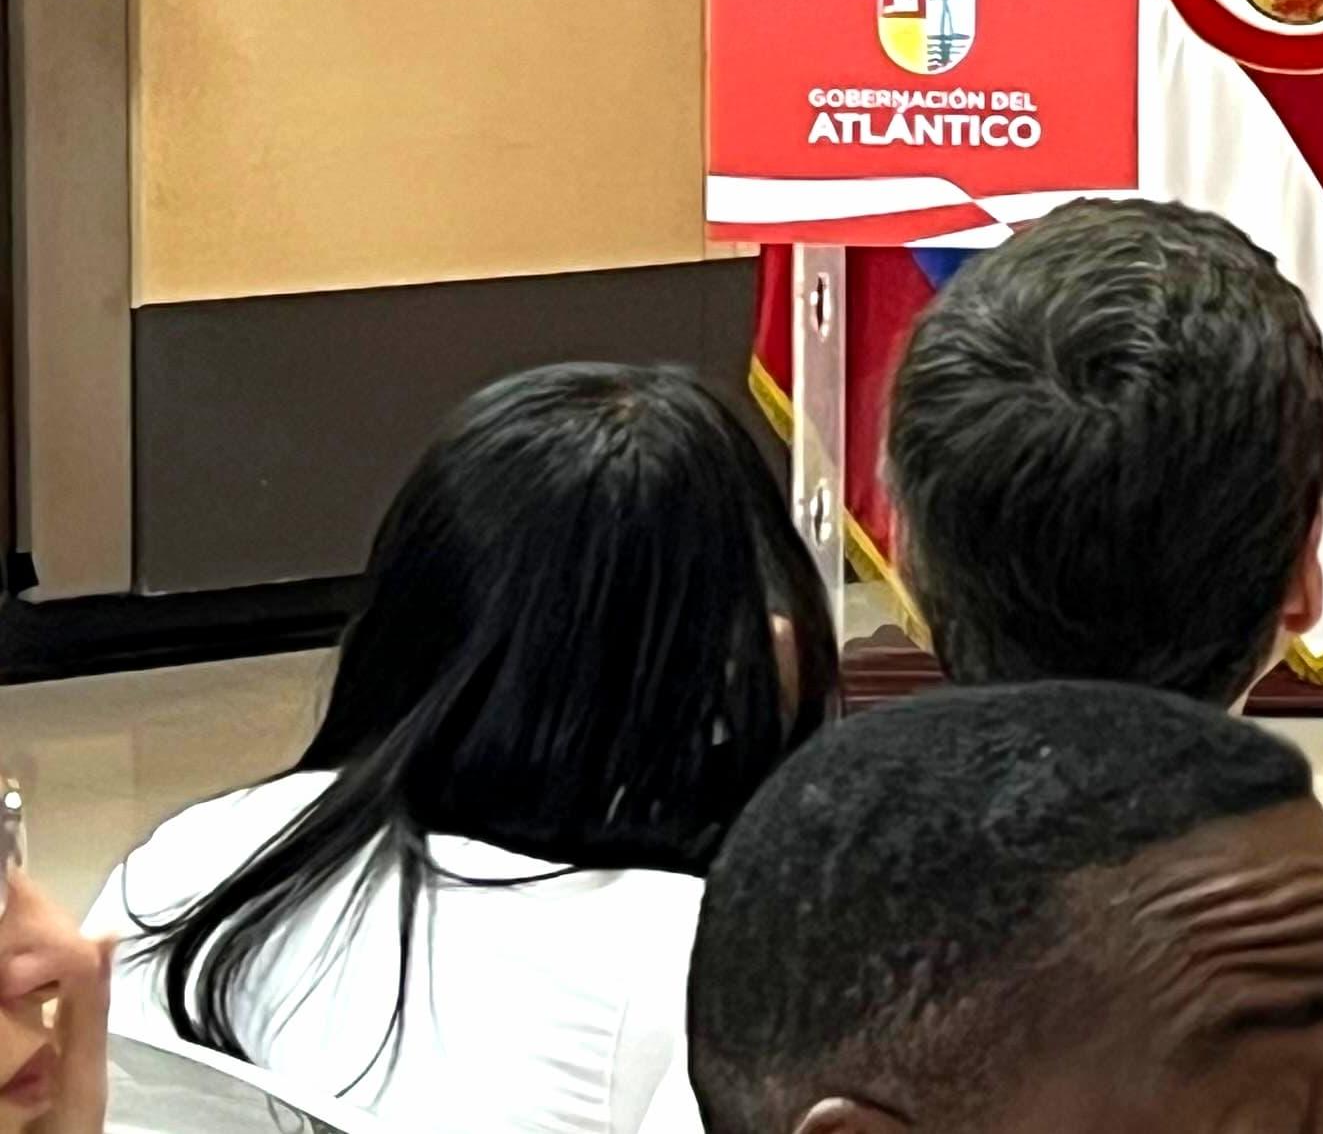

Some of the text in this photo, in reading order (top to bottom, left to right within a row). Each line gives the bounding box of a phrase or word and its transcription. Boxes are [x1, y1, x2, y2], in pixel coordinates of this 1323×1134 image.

[808, 87, 1038, 112] GOBERNACIÓN DEL
[808, 106, 1042, 148] ATLÁNTICO
